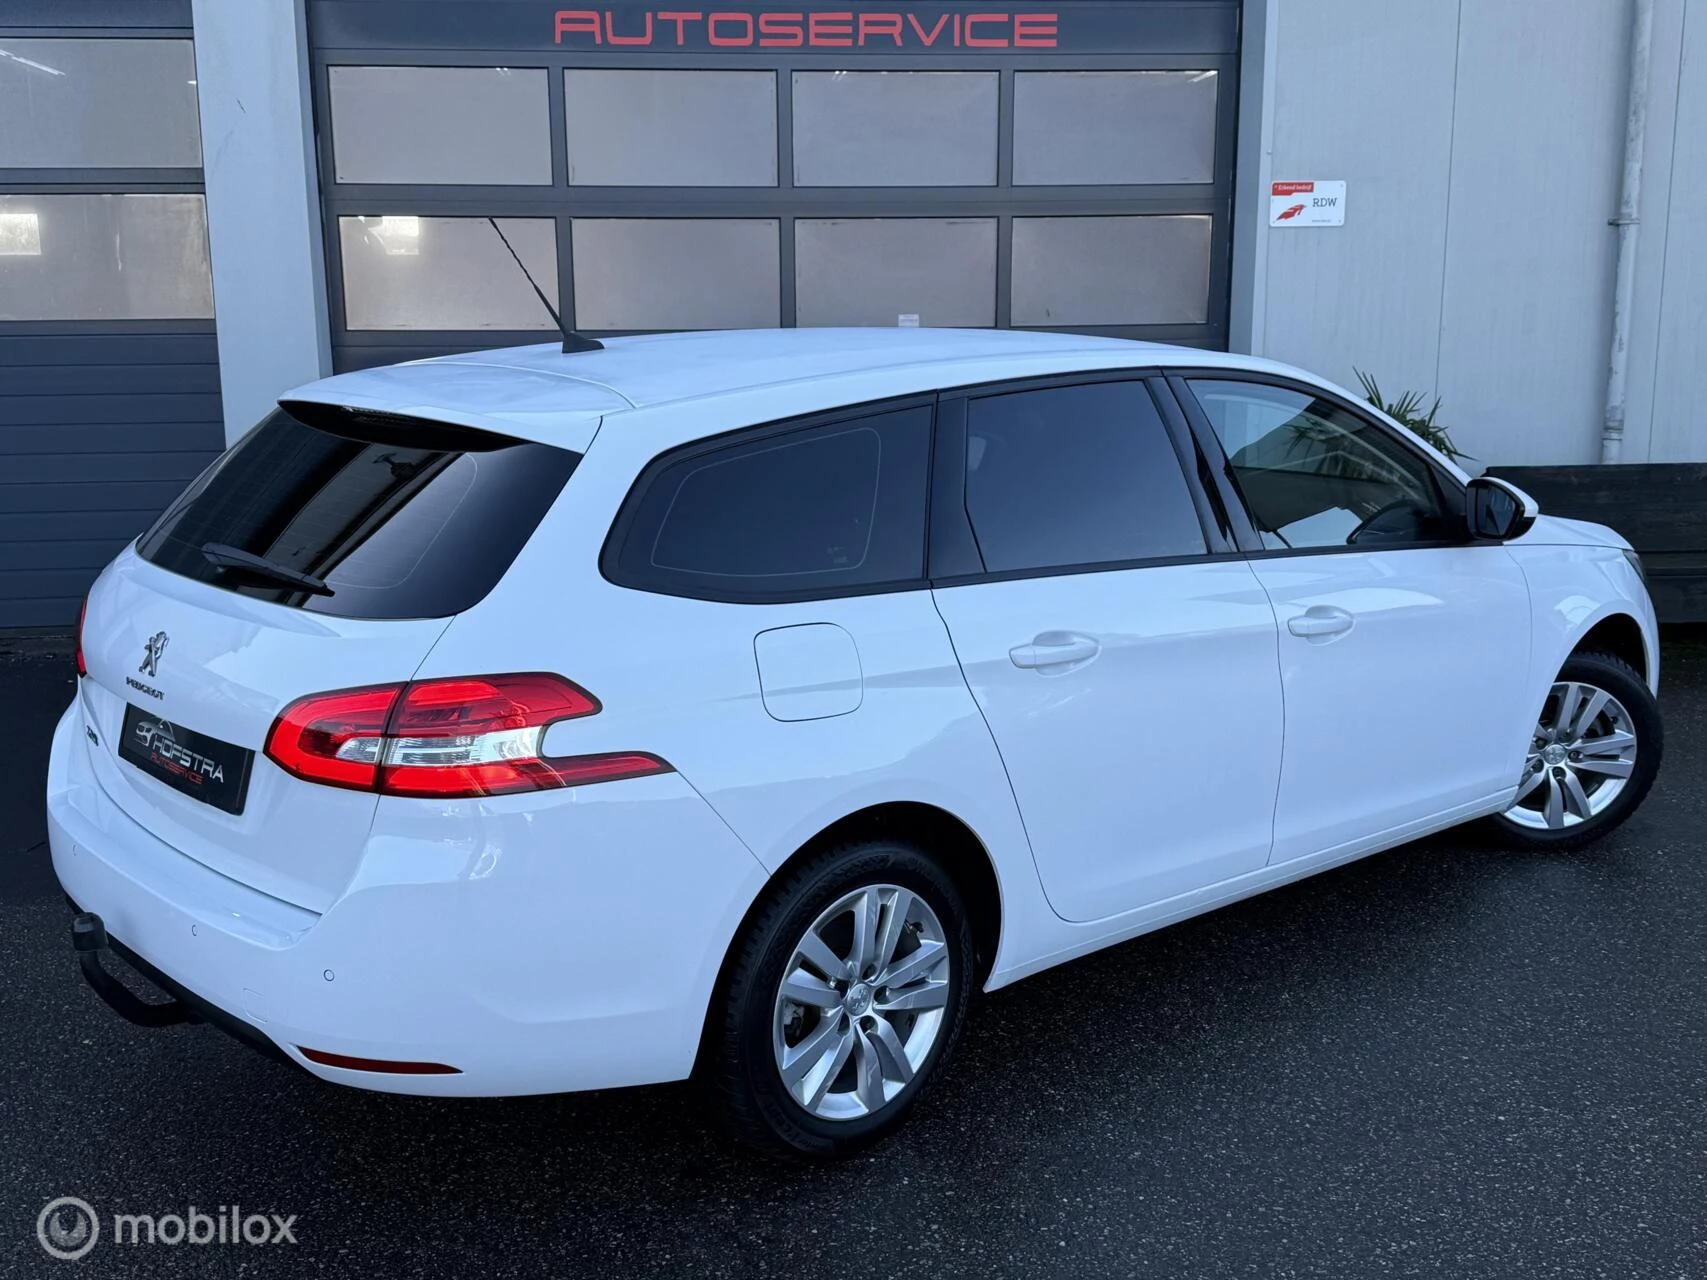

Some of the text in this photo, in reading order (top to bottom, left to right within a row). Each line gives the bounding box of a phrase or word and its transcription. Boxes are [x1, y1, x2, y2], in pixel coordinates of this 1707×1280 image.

[554, 10, 1058, 48] AUTOSERVICE
[1312, 197, 1338, 208] RDW
[152, 734, 224, 784] HOFSTRA
